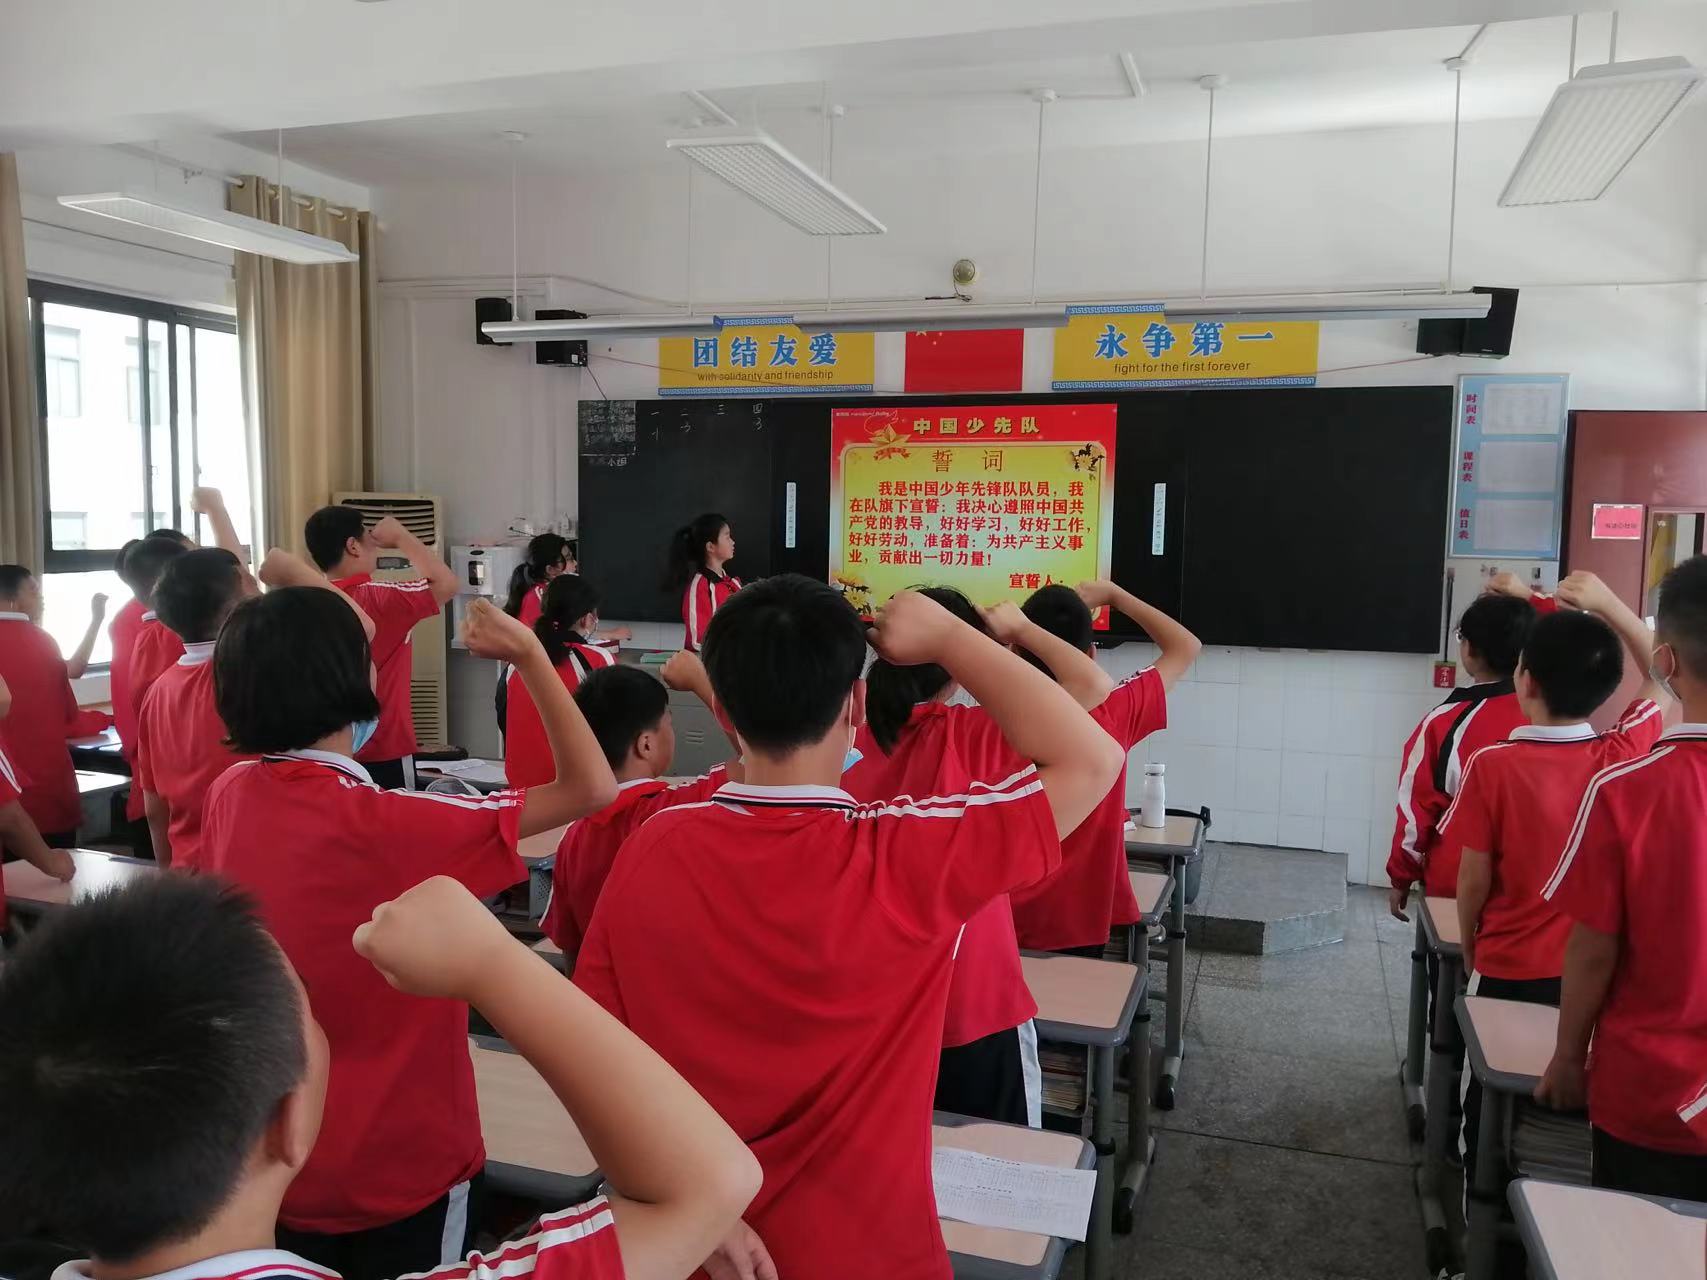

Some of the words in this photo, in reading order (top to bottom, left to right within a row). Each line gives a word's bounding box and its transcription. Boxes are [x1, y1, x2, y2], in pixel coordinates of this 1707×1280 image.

[1095, 322, 1275, 359] 永争第一
[693, 333, 837, 368] 团结友爱
[697, 372, 716, 381] with
[719, 371, 762, 382] solidarity
[765, 371, 782, 380] and
[785, 370, 833, 381] friendship
[1114, 363, 1140, 375] fight
[1142, 363, 1158, 373] for
[1161, 362, 1178, 372] the
[1182, 362, 1205, 371] first
[1207, 361, 1250, 371] forever
[1464, 394, 1478, 425] 时间表
[913, 416, 1040, 435] 中国少先队
[932, 449, 1004, 473] 誓词
[1461, 452, 1474, 482] 课程表
[879, 480, 1084, 497] 我是中国少年先锋队队员，我
[849, 498, 1084, 515] 在队旗下宣誓：我决心遵照中国共
[849, 516, 1091, 533] 产党的教导，好好学习，好好工作，
[1457, 508, 1471, 540] 值日表
[849, 532, 1084, 551] 好好劳动，准备着：为共产主义事
[848, 549, 992, 567] 业，贡献出一切力量！
